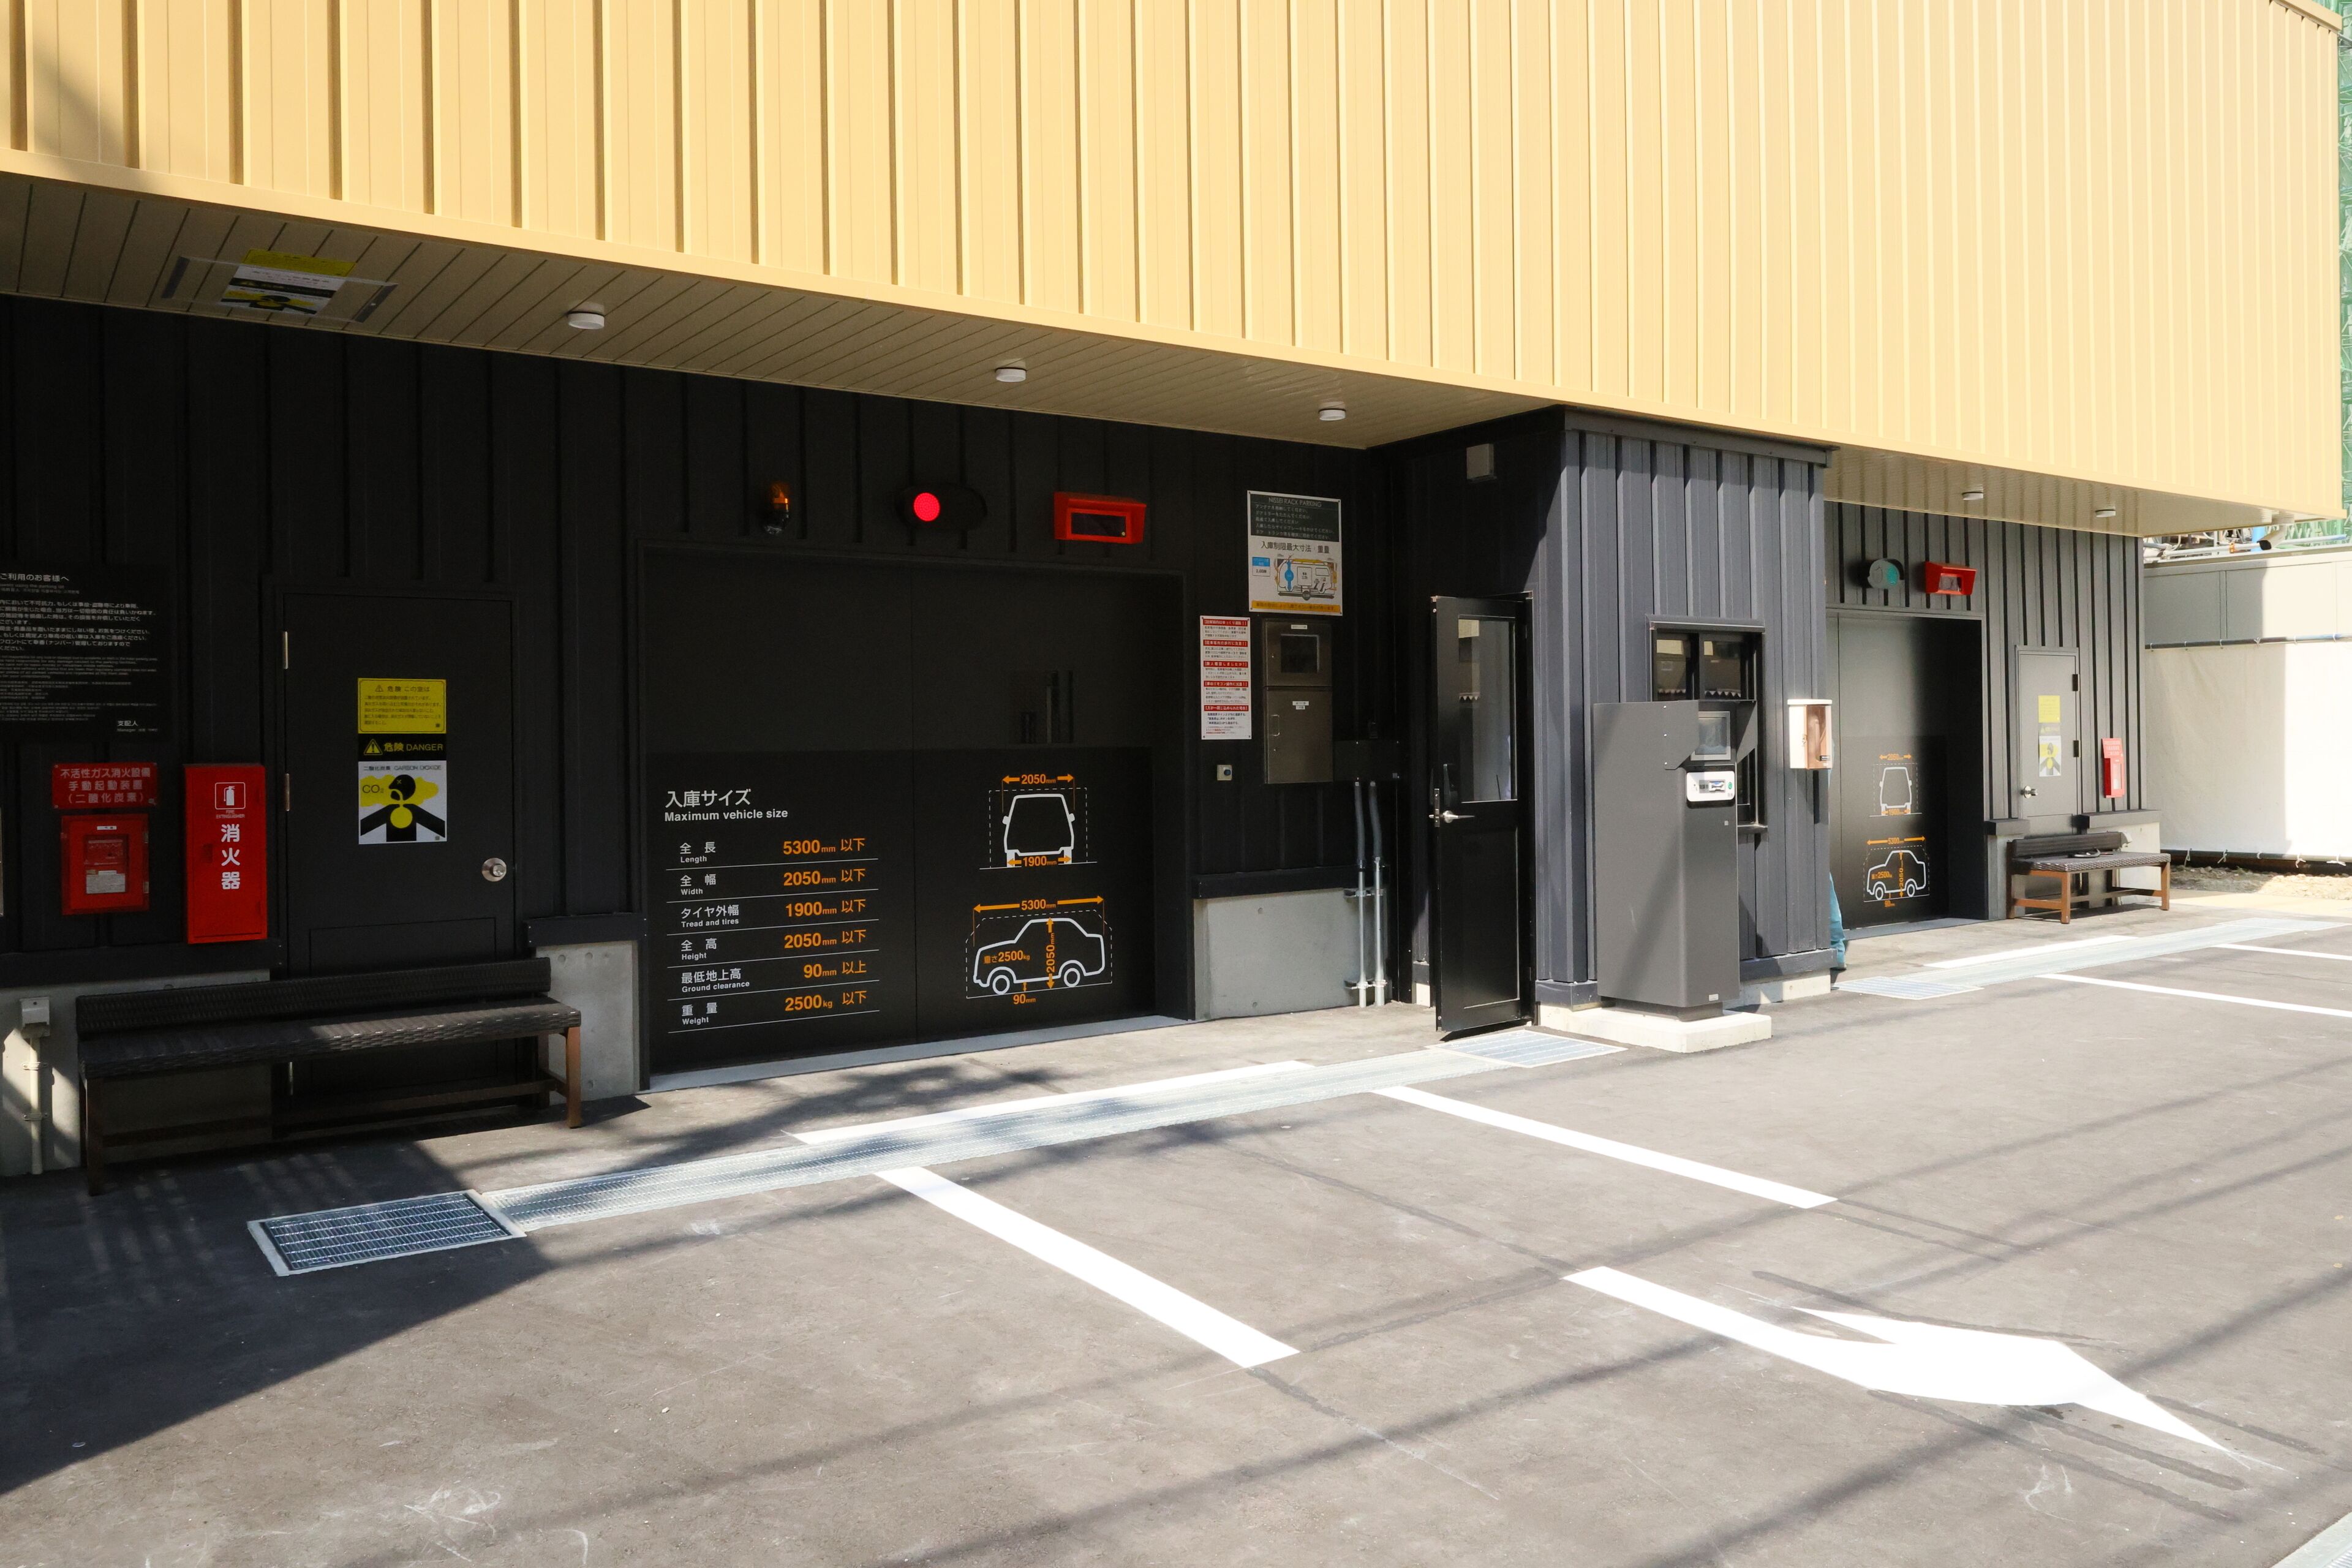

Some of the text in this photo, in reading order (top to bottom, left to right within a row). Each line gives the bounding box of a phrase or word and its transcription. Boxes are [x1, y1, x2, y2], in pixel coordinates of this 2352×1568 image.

[384, 742, 404, 752] 危険
[60, 767, 151, 780] 不活性ガス消火設備
[1021, 774, 1057, 785] 2050mm
[69, 780, 143, 791] 手動起動装置
[665, 788, 752, 809] 入庫サイズ
[664, 809, 788, 822] Maximum vehicle size
[840, 837, 866, 852] 以下
[221, 823, 241, 891] 消火器
[680, 856, 707, 864] Length
[1022, 856, 1057, 867] 1900mm
[840, 868, 866, 883] 以下
[681, 904, 739, 919] タイヤ外幅
[841, 899, 867, 913] 以下
[1021, 899, 1056, 911] 5300mm
[842, 929, 867, 944] 以下
[681, 952, 707, 961] Height
[681, 968, 742, 984] 最低地上高
[842, 960, 867, 975] 以上
[682, 981, 750, 993] Ground clearance
[842, 990, 867, 1006] 以下
[1012, 994, 1036, 1005] 90mm
[682, 1017, 709, 1025] Weight
